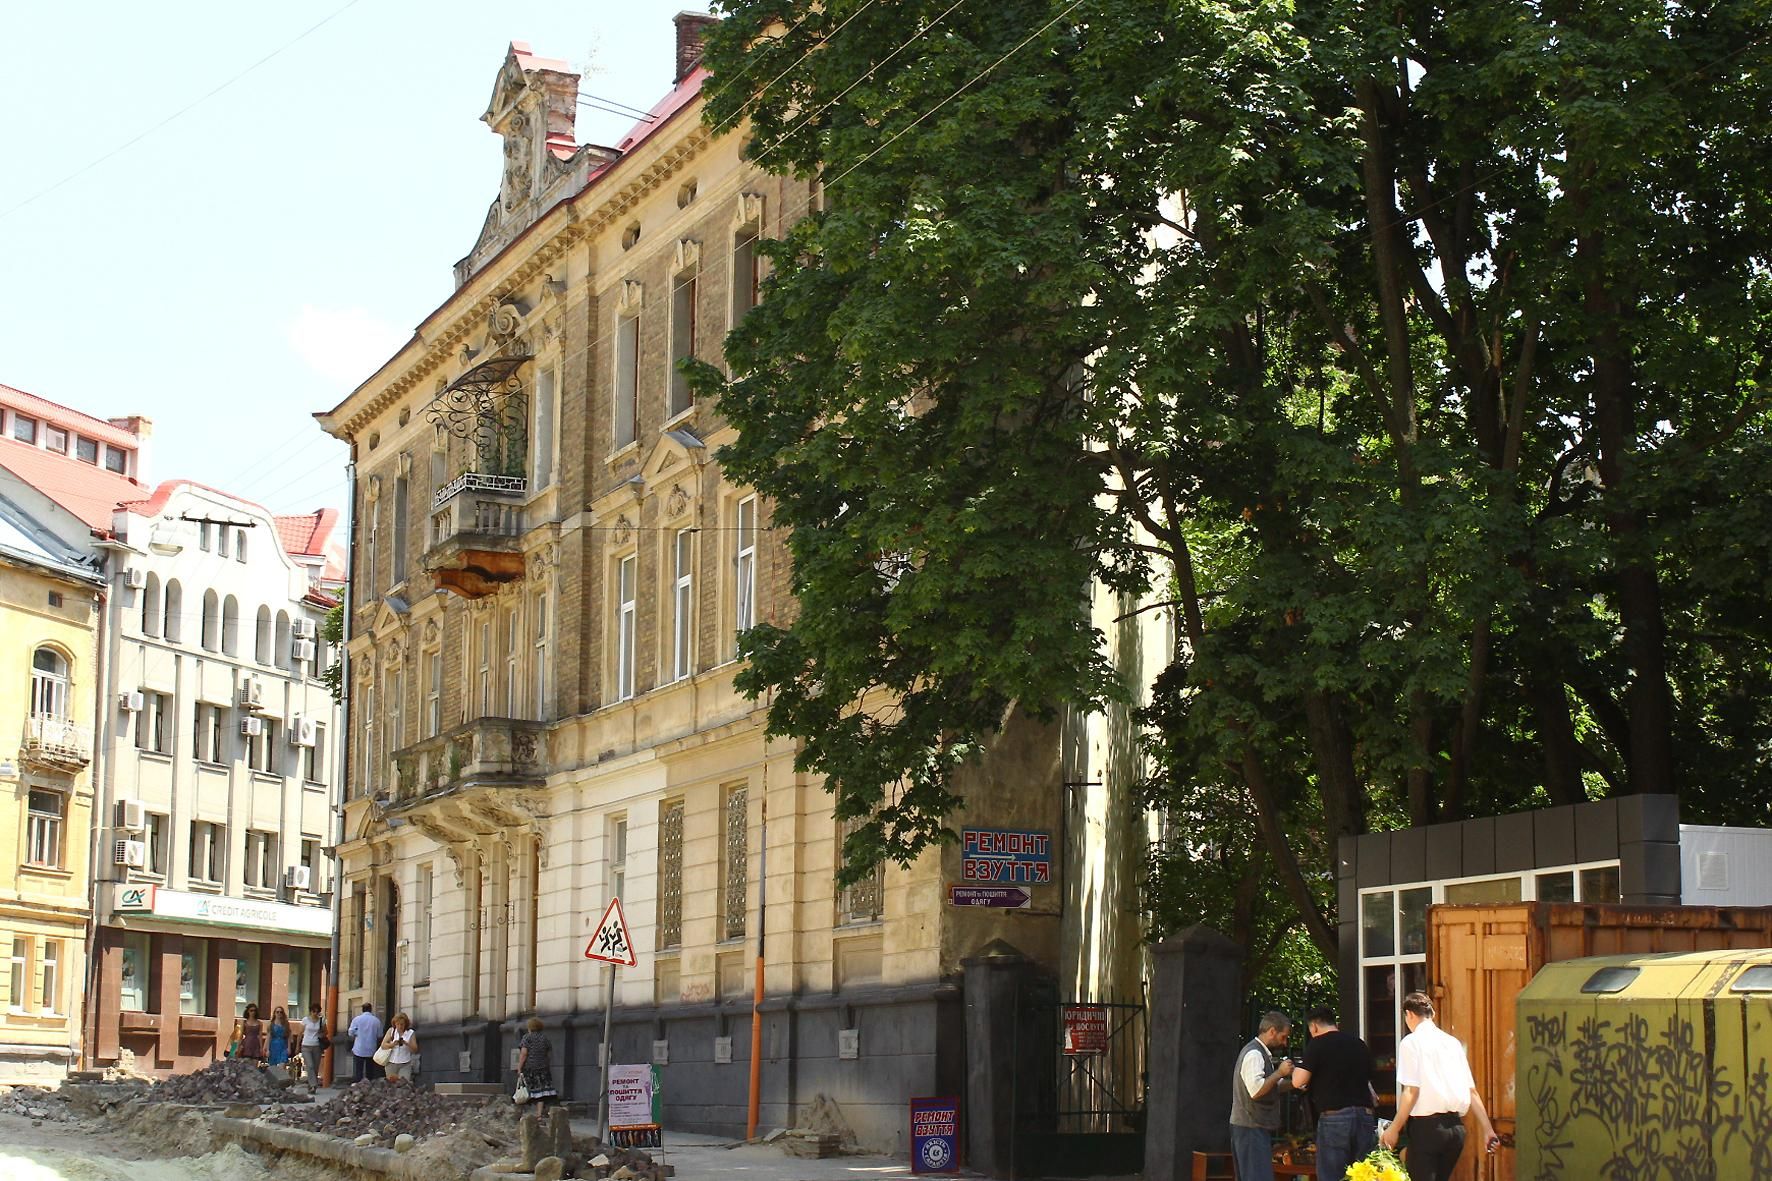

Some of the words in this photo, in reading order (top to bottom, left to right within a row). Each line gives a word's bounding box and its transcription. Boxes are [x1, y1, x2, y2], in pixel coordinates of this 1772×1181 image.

[963, 831, 1048, 855] РЕМОНТ
[963, 859, 1049, 882] ВЗУТТЯ
[955, 890, 977, 898] РЕМОНТ
[240, 908, 277, 921] AGRICOLE
[914, 1110, 955, 1124] РЕМОНТ
[915, 1124, 954, 1137] ВЗУТТЯ
